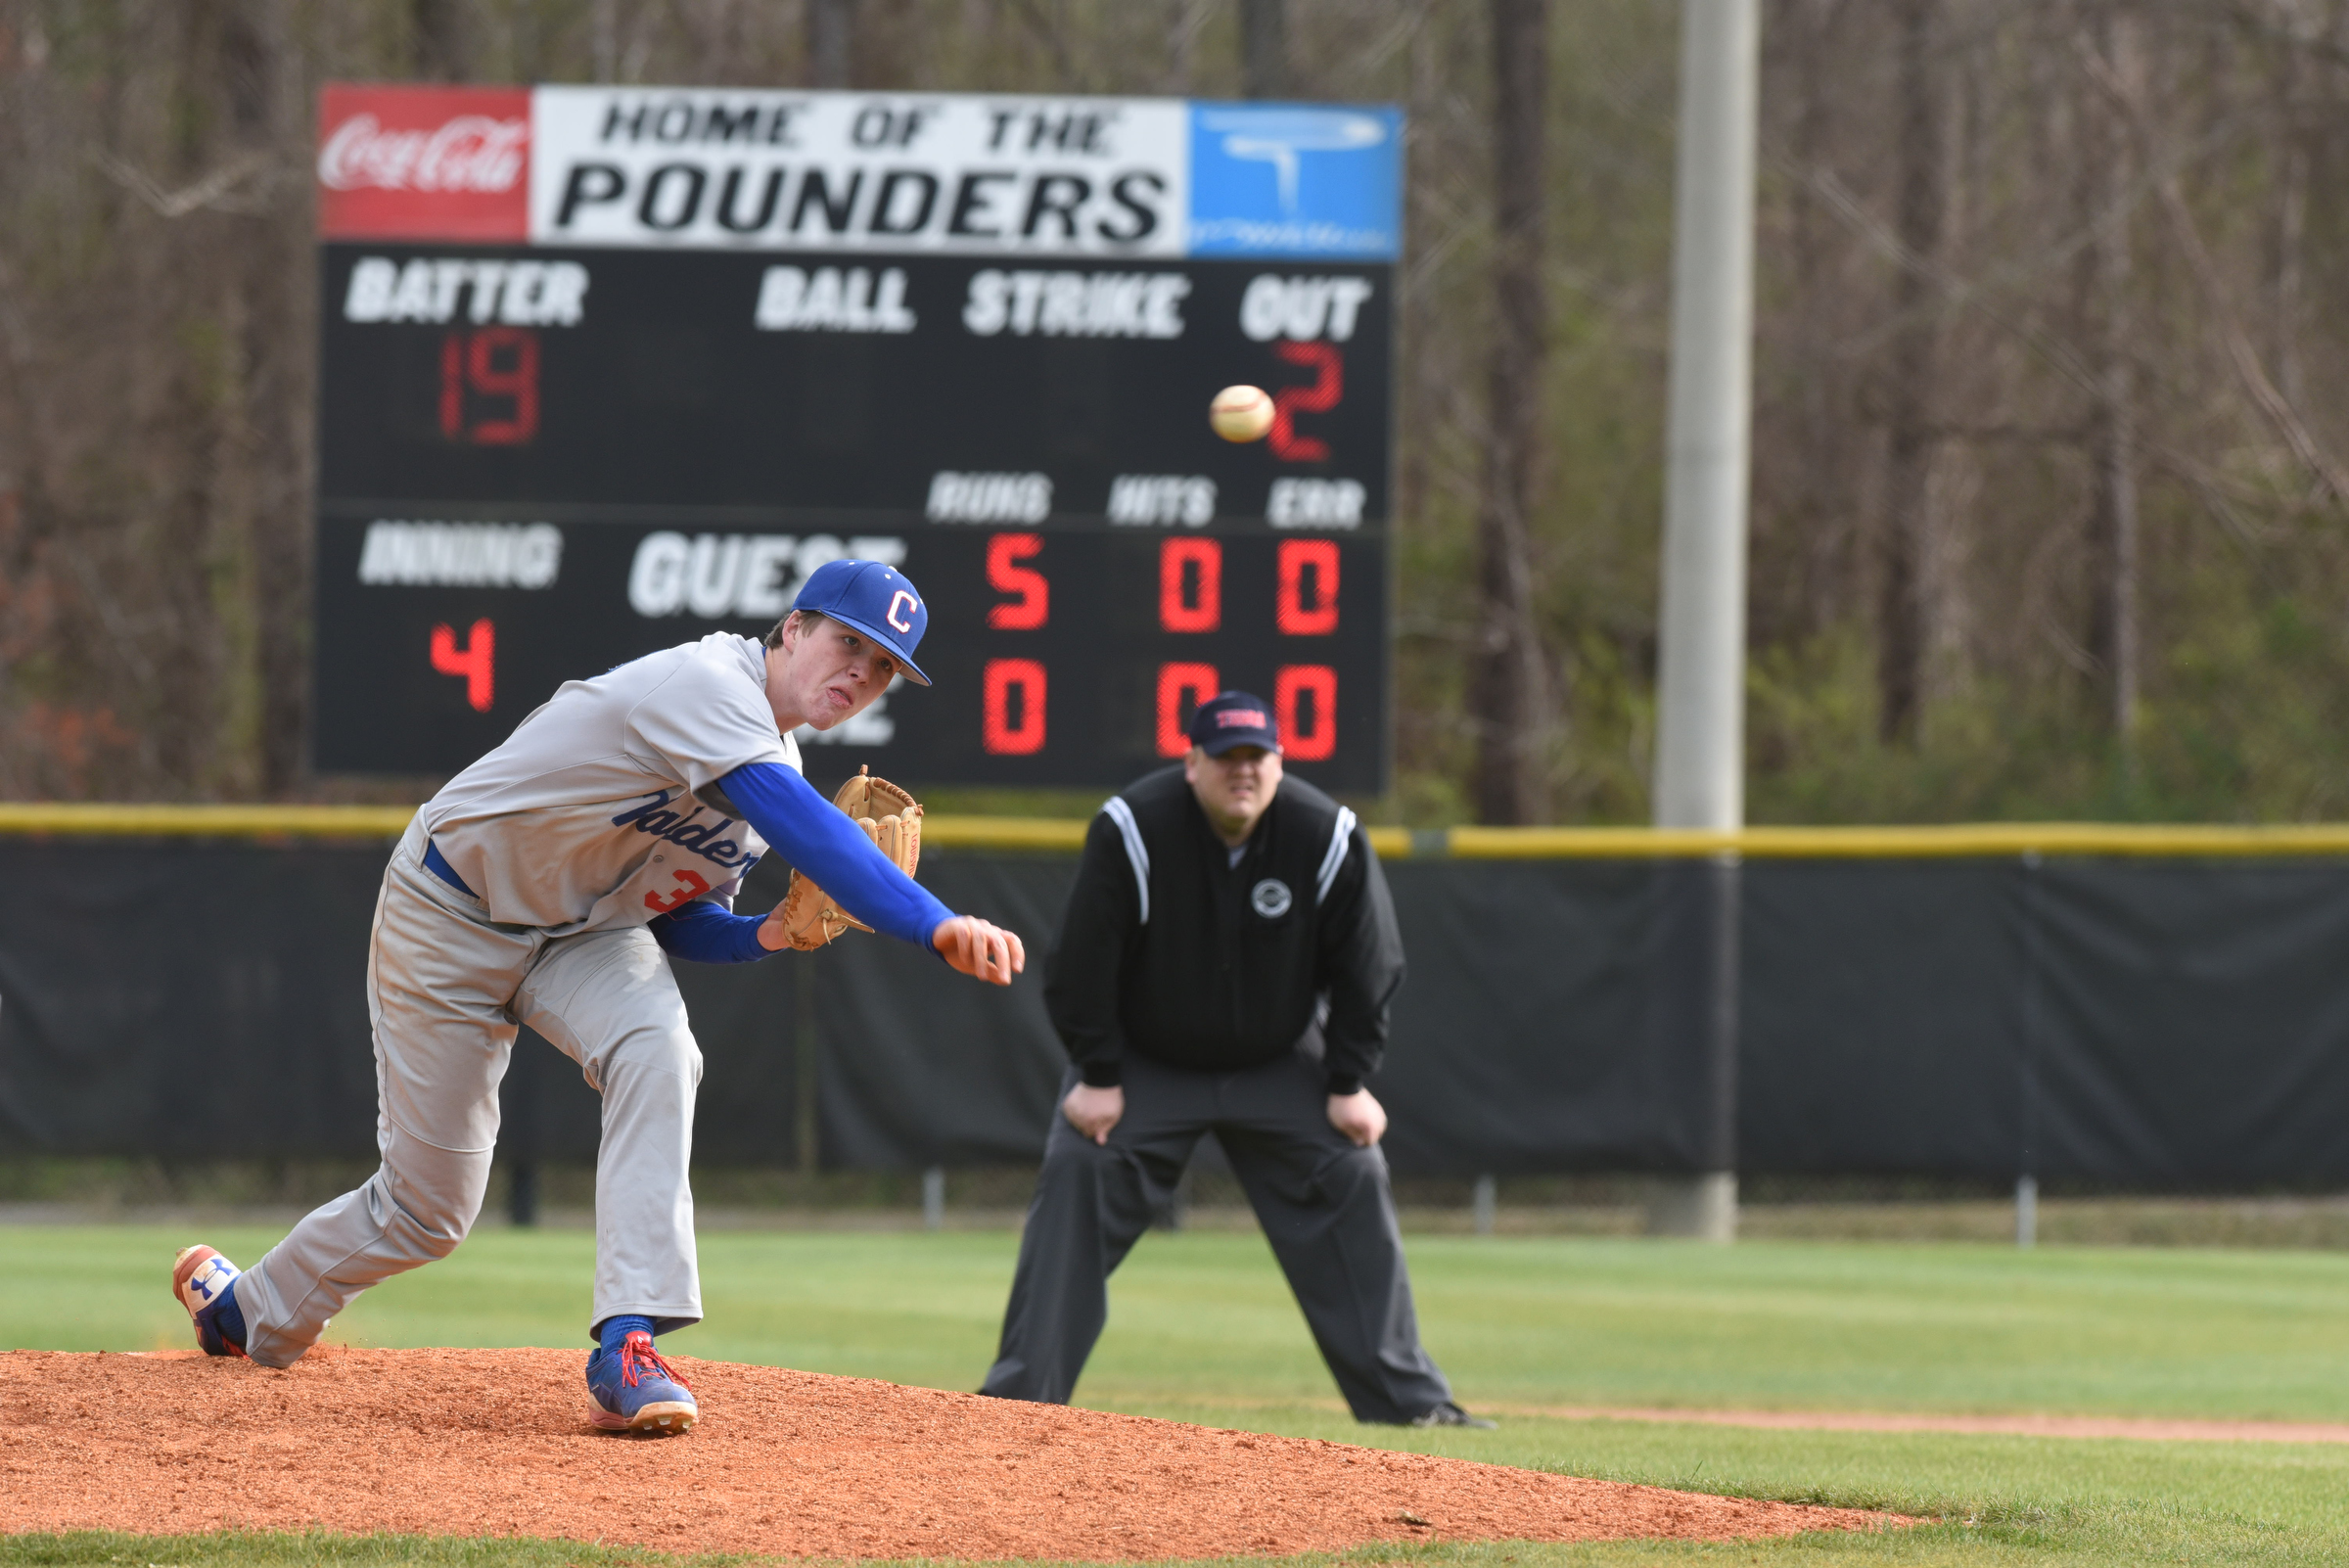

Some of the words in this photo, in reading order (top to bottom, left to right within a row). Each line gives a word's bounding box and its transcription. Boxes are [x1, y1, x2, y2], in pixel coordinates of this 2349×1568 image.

[599, 103, 803, 148] HOME
[850, 106, 932, 151] OF
[987, 109, 1114, 156] THE
[554, 161, 1167, 243] POUNDERS
[345, 257, 588, 325] BATTER
[756, 266, 914, 332] BALL
[964, 270, 1189, 337] STRIKE
[1241, 276, 1370, 341] OUT
[438, 326, 539, 444] 19
[1267, 341, 1343, 460] 2
[926, 472, 1051, 524] RUNS
[1108, 476, 1216, 527] HITS
[1267, 478, 1365, 529] ERR
[359, 523, 562, 587] INNING
[986, 532, 1050, 630] 5
[1159, 536, 1222, 632] 0
[1276, 538, 1341, 635] 0
[886, 589, 918, 634] C
[429, 618, 495, 712] 4
[983, 658, 1047, 755] 0
[1274, 664, 1338, 761] 0
[644, 869, 711, 913] 3
